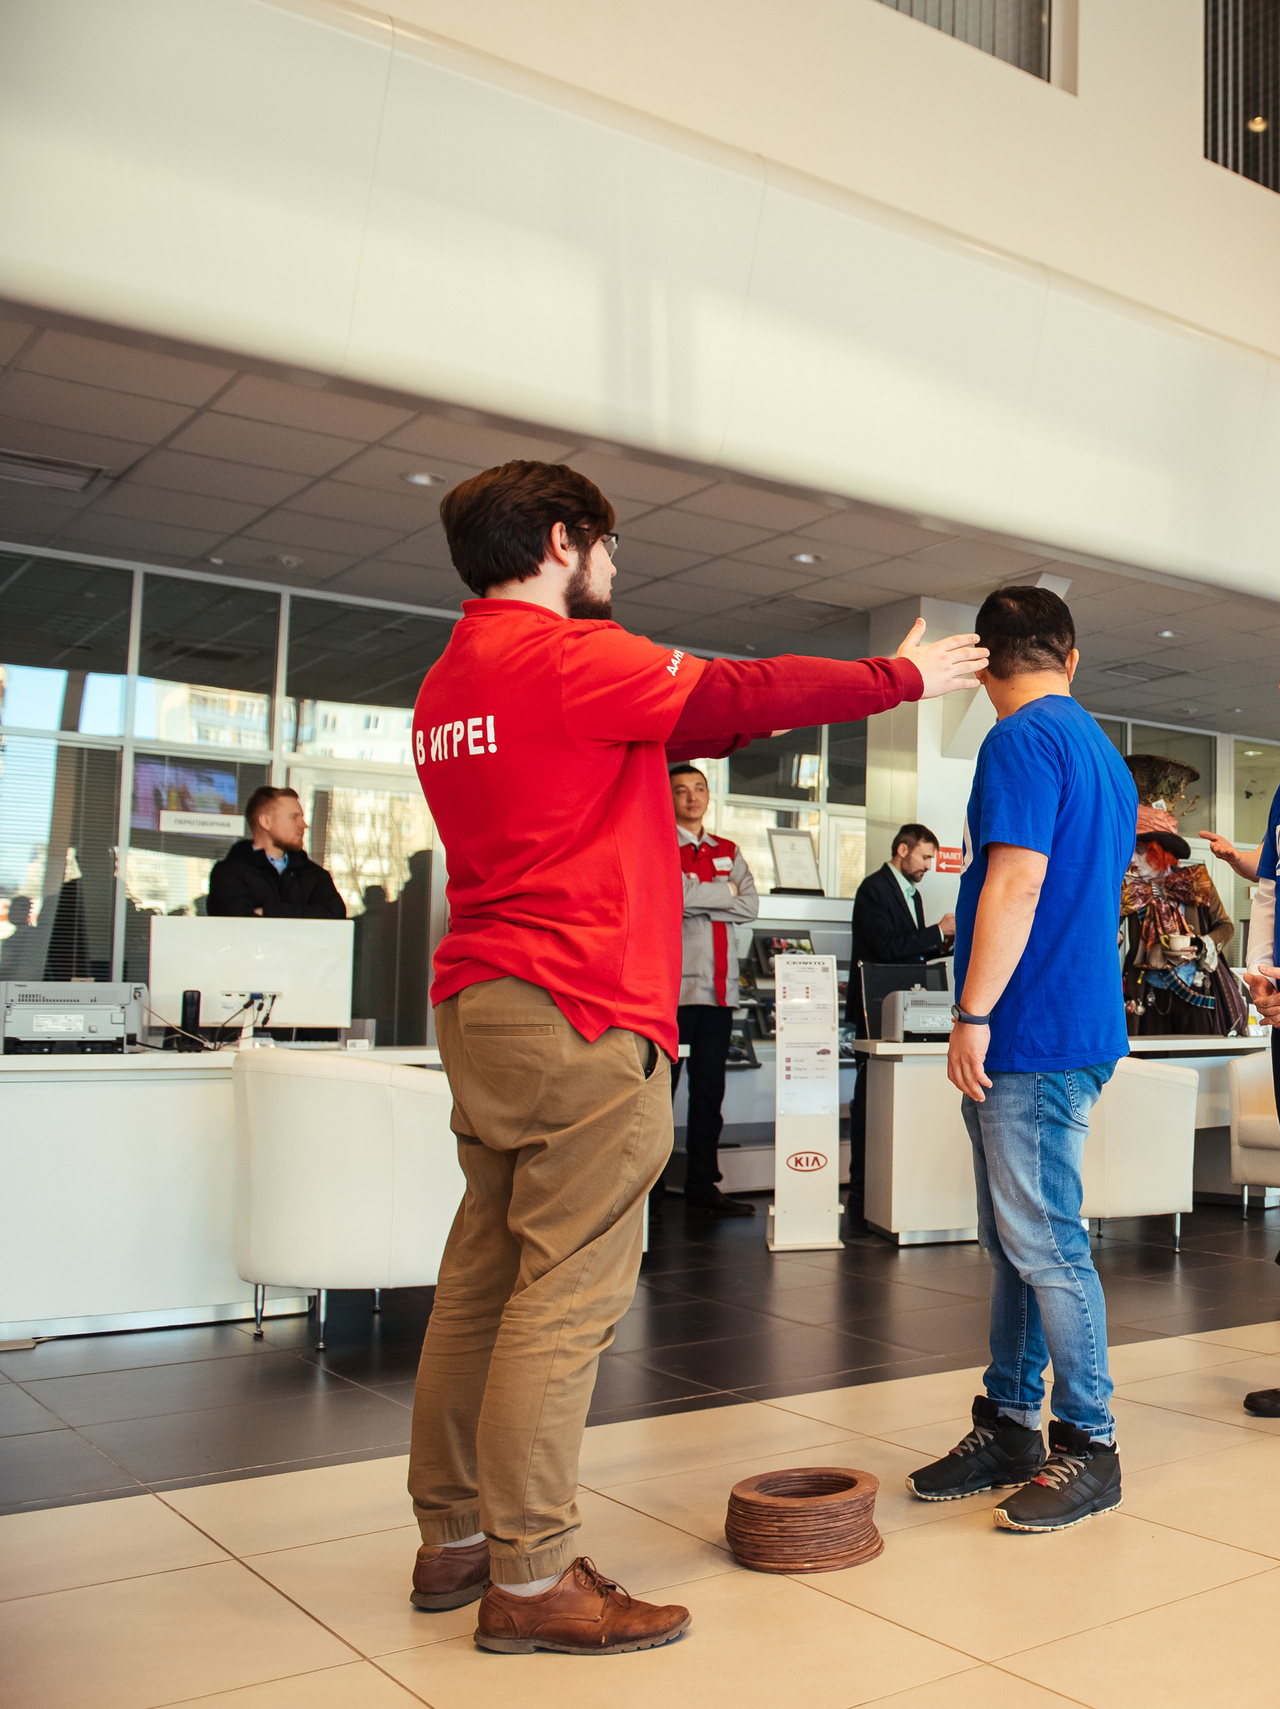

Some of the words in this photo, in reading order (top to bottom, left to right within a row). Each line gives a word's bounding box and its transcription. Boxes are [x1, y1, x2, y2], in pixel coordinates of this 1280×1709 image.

[416, 730, 426, 766] В
[430, 715, 498, 762] ИГРЕ!
[794, 1156, 821, 1168] KIA
